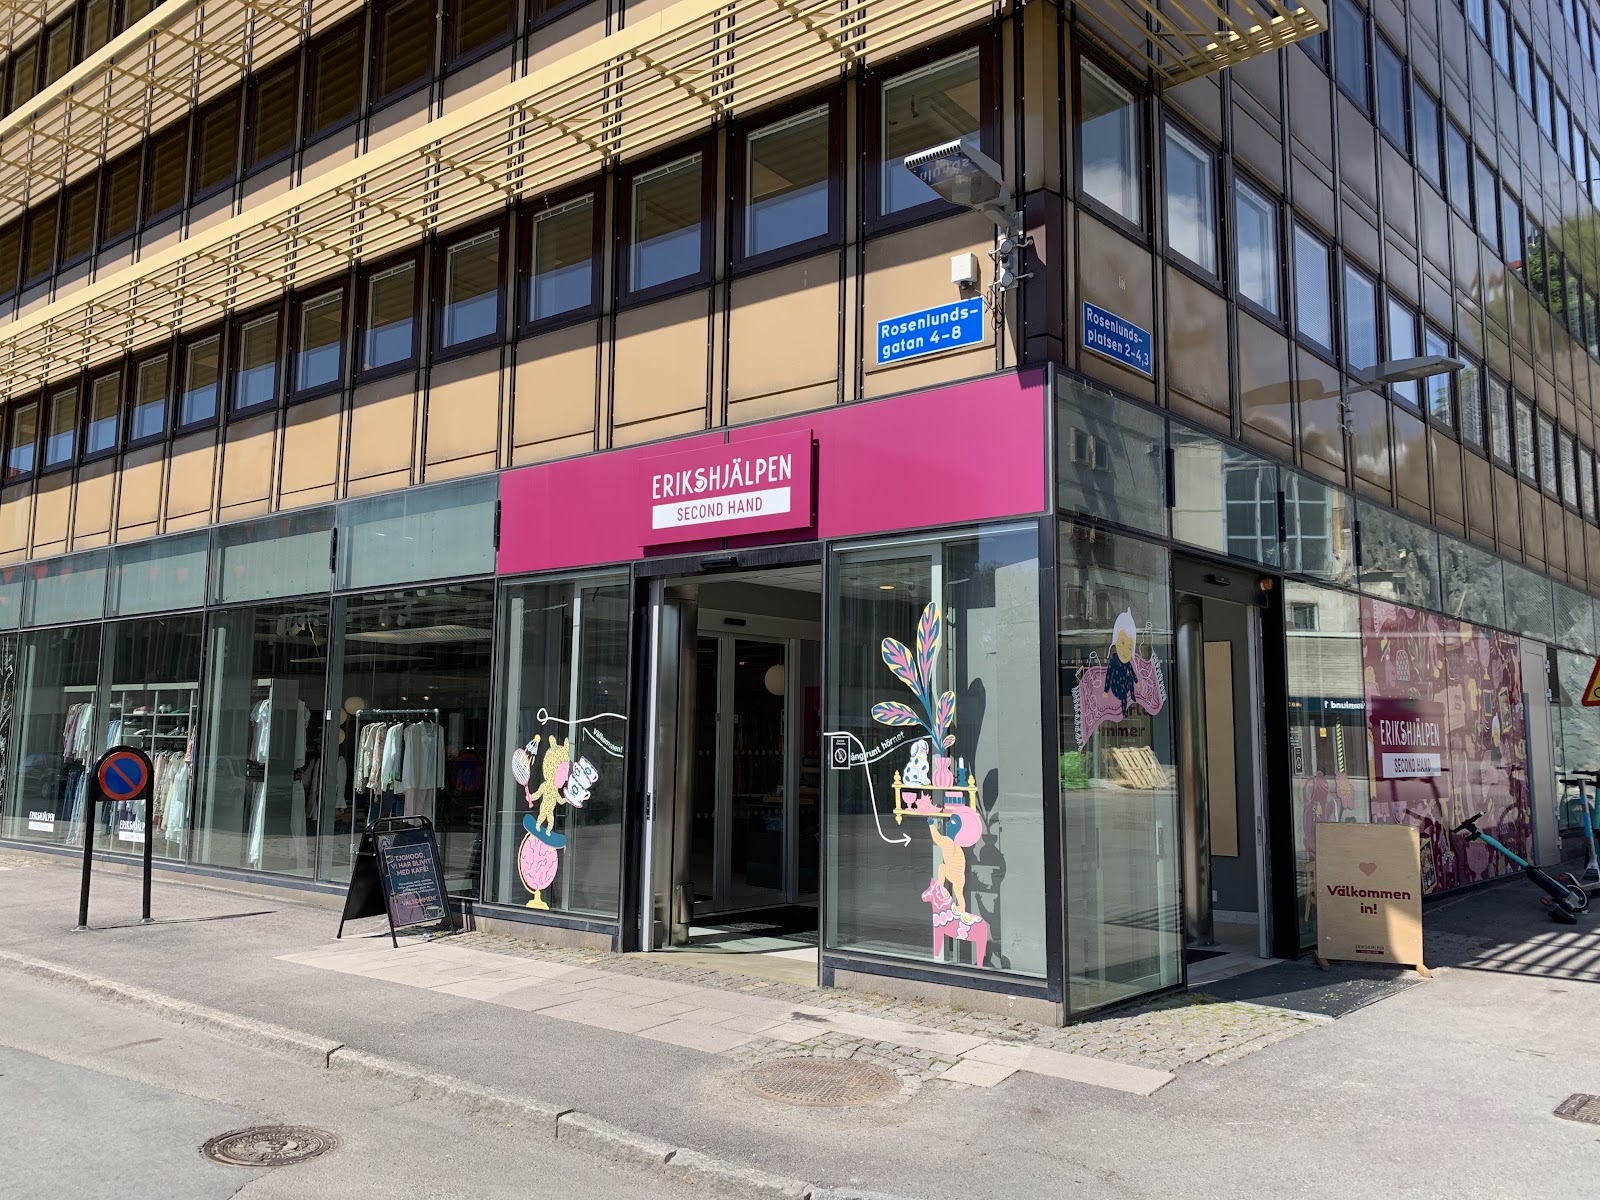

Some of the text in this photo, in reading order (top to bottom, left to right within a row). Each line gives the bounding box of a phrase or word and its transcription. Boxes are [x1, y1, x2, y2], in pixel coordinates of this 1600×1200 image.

[881, 307, 979, 338] Rosenlunds-
[1086, 307, 1143, 344] Rosenlunds-
[882, 337, 924, 359] gatan
[1088, 329, 1122, 353] platsen
[652, 453, 792, 500] ERIKSHJÄLPEN
[677, 497, 763, 521] SECOND HAND
[866, 746, 881, 757] runt
[880, 731, 905, 750] hörnet
[1380, 718, 1440, 746] ERIKSHJÄLPEN
[1394, 758, 1432, 773] SECOND HAND
[396, 868, 410, 876] MED
[398, 861, 412, 869] HAR
[412, 857, 432, 867] BLIVIT
[1327, 885, 1411, 900] Välkommen
[1360, 902, 1378, 914] in!
